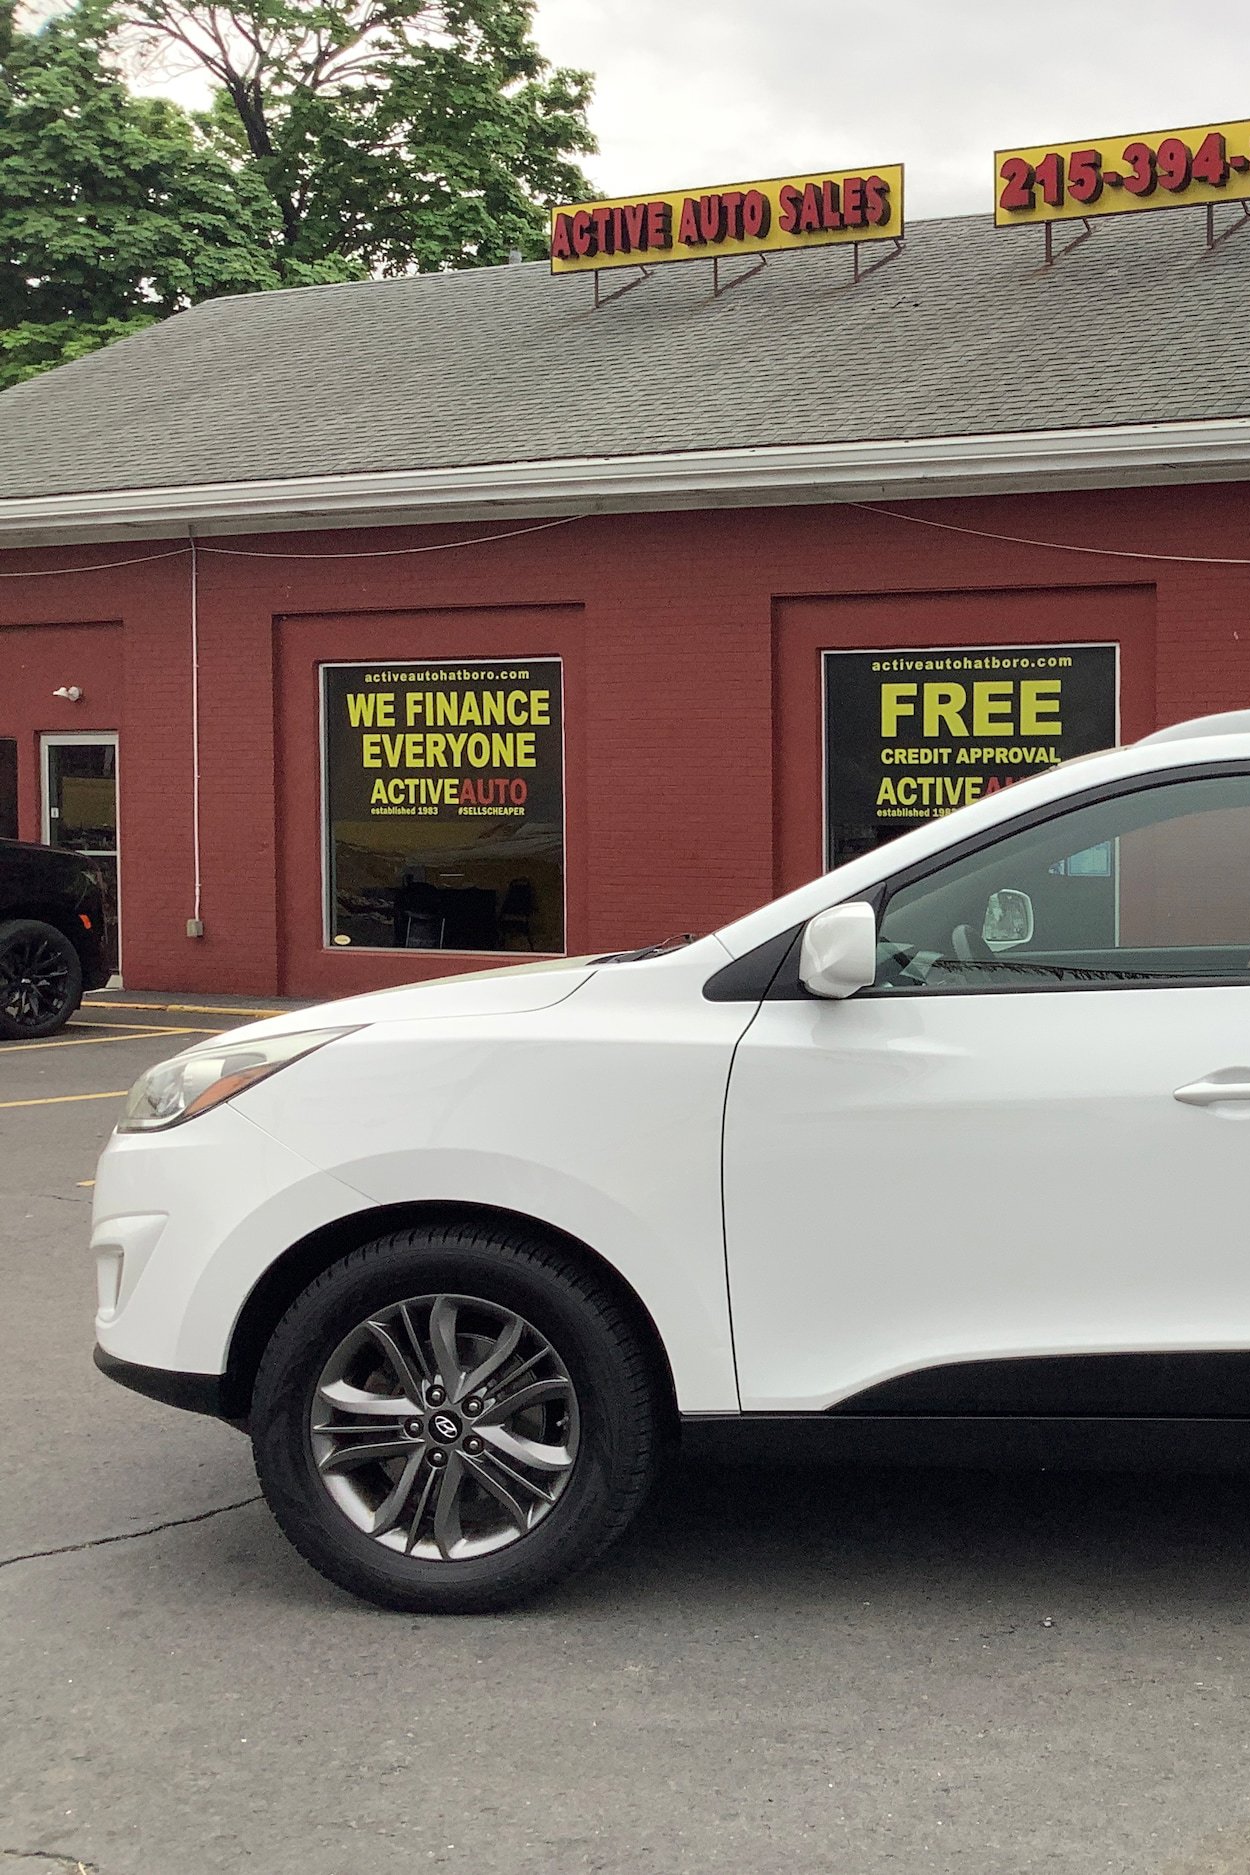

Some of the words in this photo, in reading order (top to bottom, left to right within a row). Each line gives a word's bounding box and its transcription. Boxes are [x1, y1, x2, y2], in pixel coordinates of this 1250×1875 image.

[552, 202, 672, 260] ACTIVE
[678, 190, 771, 247] AUTO
[779, 176, 891, 234] SALES
[873, 656, 1073, 671] activeautohatboro.com
[364, 669, 530, 683] activeautohatboro.com
[347, 692, 396, 728] WE
[406, 690, 550, 727] FINANCE
[881, 680, 1062, 738] FREE
[362, 732, 537, 768] EVERYONE
[881, 748, 952, 765] CREDIT
[956, 747, 1061, 765] APPROVAL
[371, 807, 416, 815] established
[418, 807, 439, 815] 1983
[458, 807, 525, 816] #SELLSCHEAPER
[877, 808, 930, 817] established
